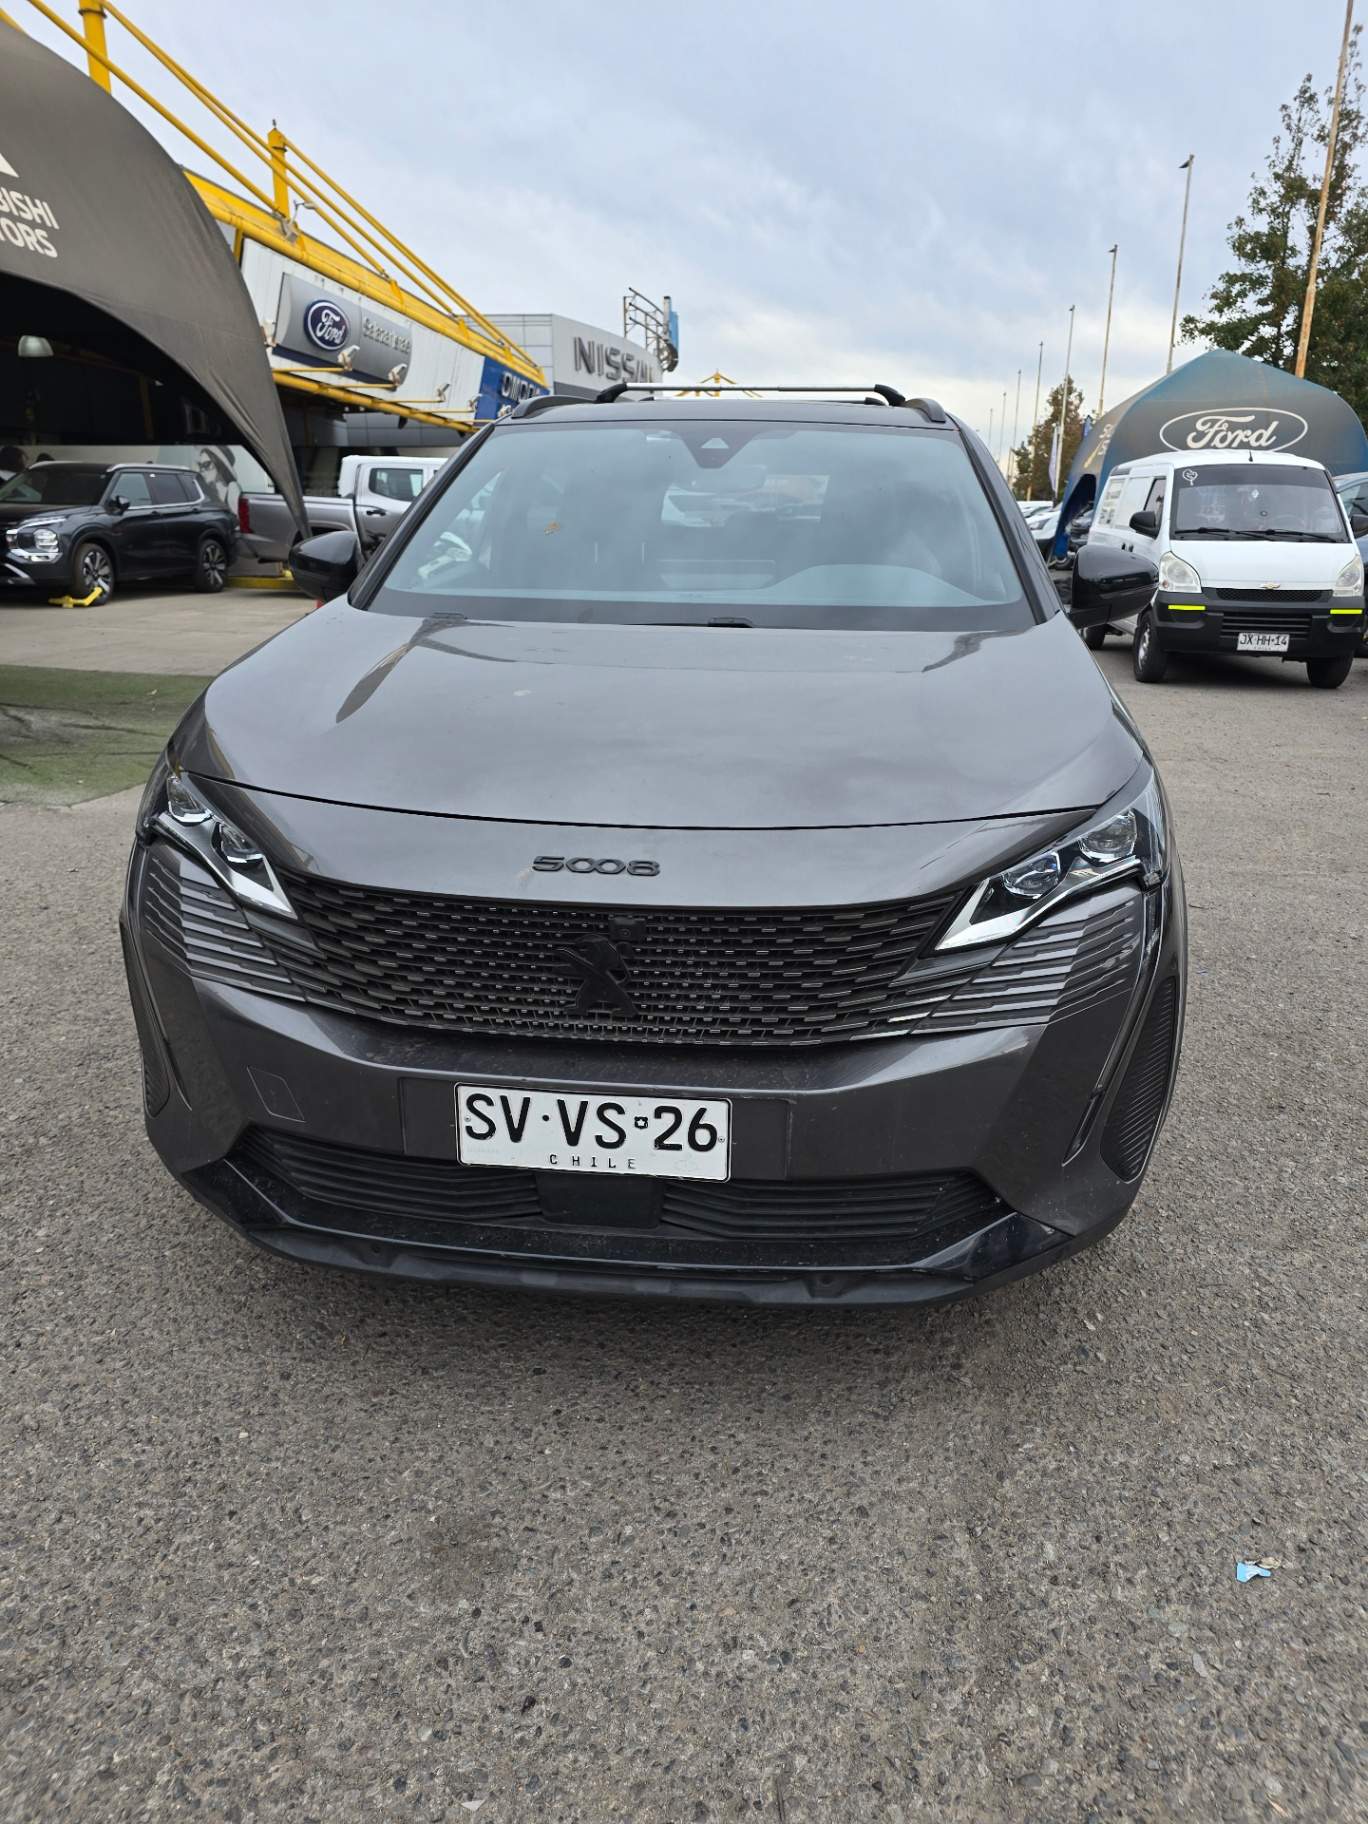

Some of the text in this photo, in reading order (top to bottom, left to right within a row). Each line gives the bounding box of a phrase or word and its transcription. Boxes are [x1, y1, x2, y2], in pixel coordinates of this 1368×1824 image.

[315, 308, 347, 345] Ford
[1186, 415, 1279, 449] Ford
[532, 855, 661, 877] 5008
[549, 1154, 637, 1169] CHILE
